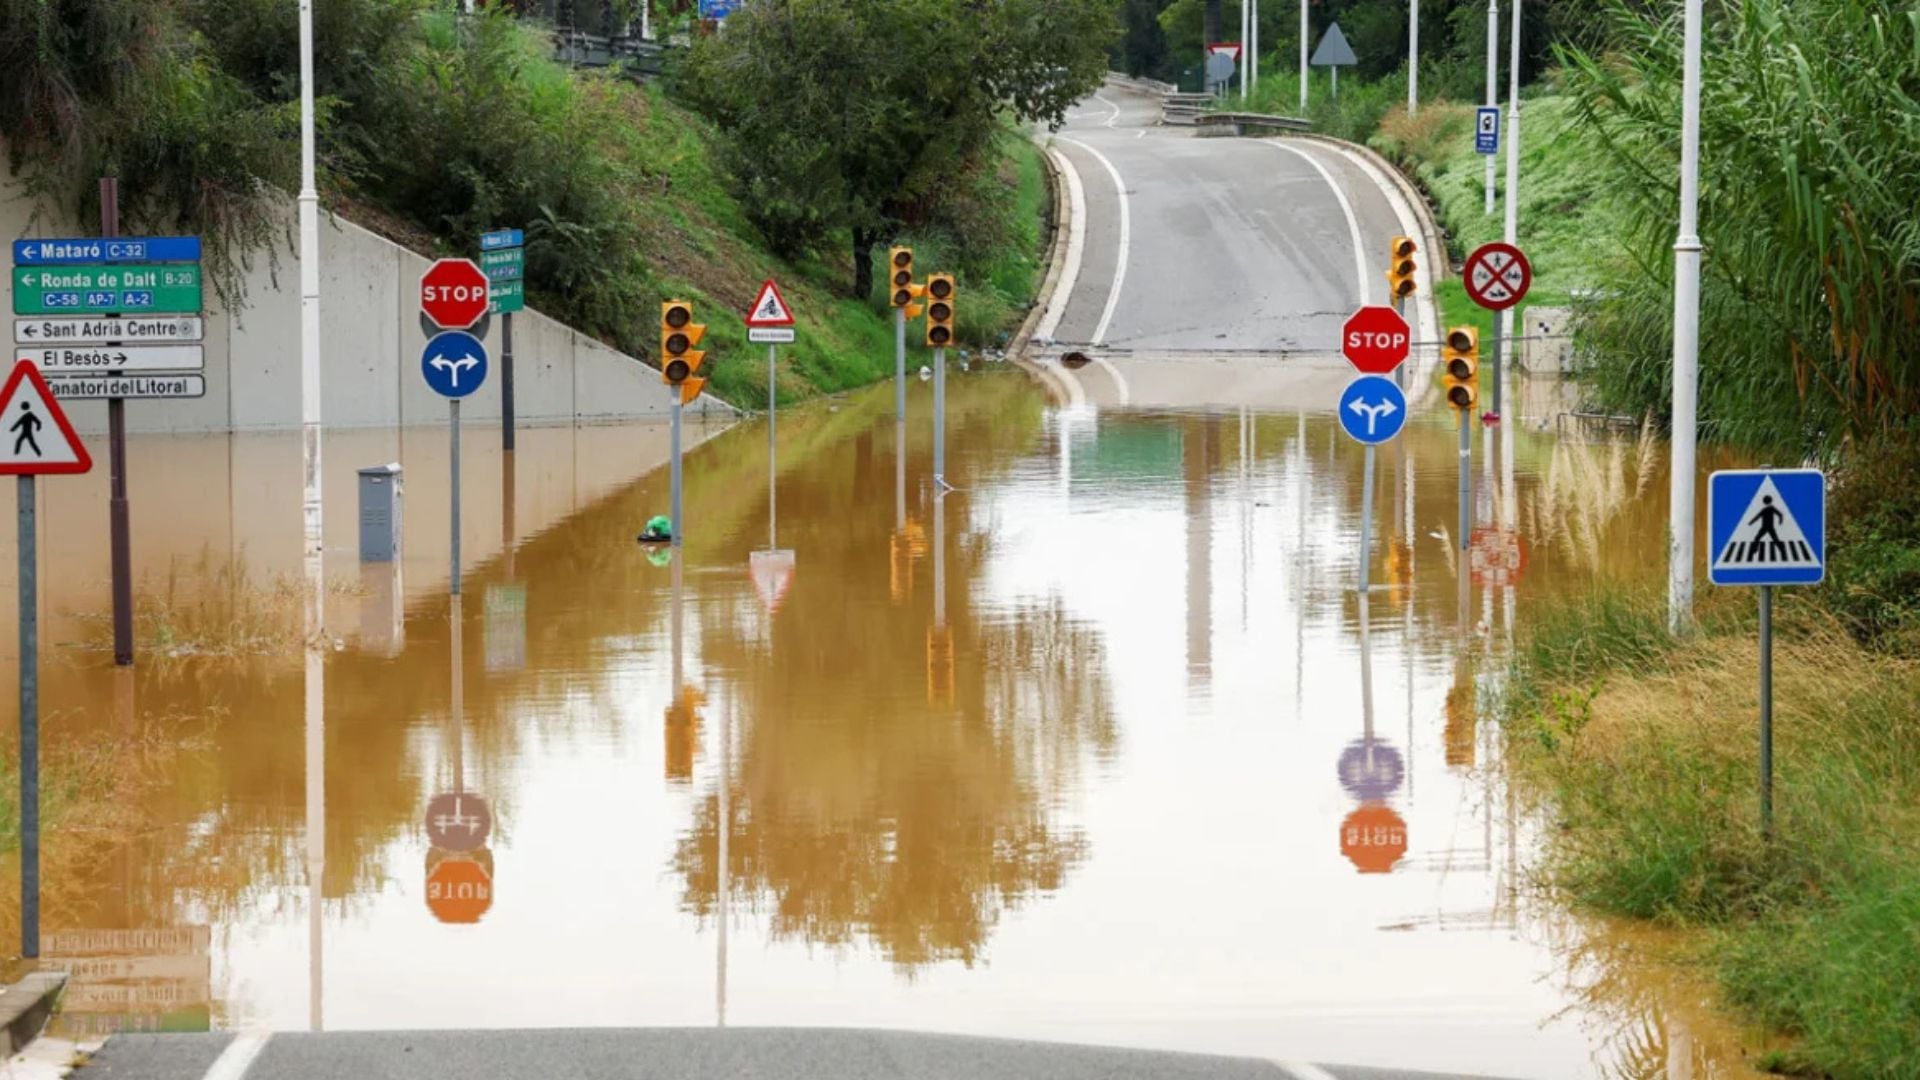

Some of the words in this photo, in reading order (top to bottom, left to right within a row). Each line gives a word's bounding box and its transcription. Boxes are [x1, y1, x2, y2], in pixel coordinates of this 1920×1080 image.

[41, 243, 100, 258] Mataró
[110, 245, 142, 257] C-32
[41, 273, 91, 287] Ronda
[98, 273, 117, 287] de
[124, 272, 156, 286] Dalt
[165, 273, 192, 284] B-20
[45, 294, 79, 305] C-58
[88, 294, 115, 305] AP-7
[125, 293, 149, 304] A-2
[423, 285, 485, 302] STOP
[43, 322, 76, 337] Sant
[82, 321, 122, 336] Adrià
[127, 320, 177, 335] Centre
[1349, 332, 1405, 348] STOP
[44, 351, 57, 365] El
[64, 350, 110, 365] Besòs
[46, 380, 107, 394] anatori
[137, 379, 187, 393] Litoral
